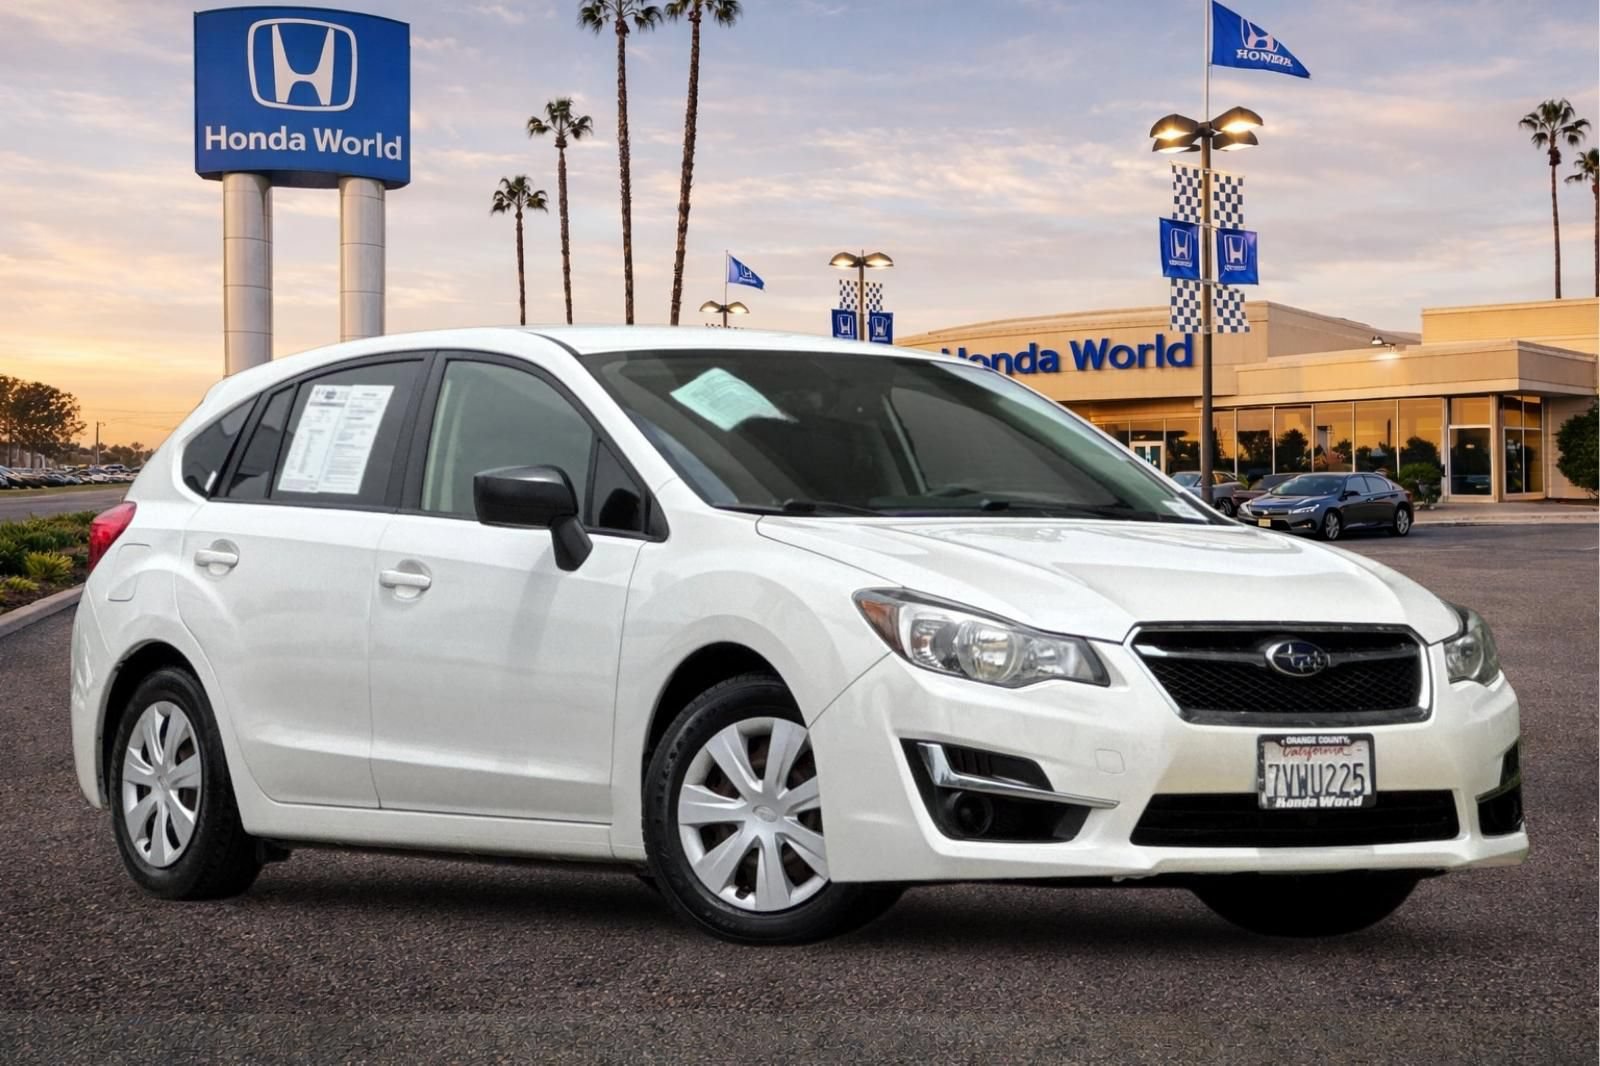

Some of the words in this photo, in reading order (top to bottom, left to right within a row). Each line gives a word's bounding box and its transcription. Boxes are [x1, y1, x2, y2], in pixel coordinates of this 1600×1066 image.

[205, 125, 306, 151] Honda
[313, 127, 402, 161] World
[1069, 333, 1194, 371] World
[1286, 736, 1316, 744] ORANGE
[1318, 736, 1348, 744] COUNTY
[1268, 763, 1365, 797] 7VWU225
[1275, 796, 1317, 808] Honda
